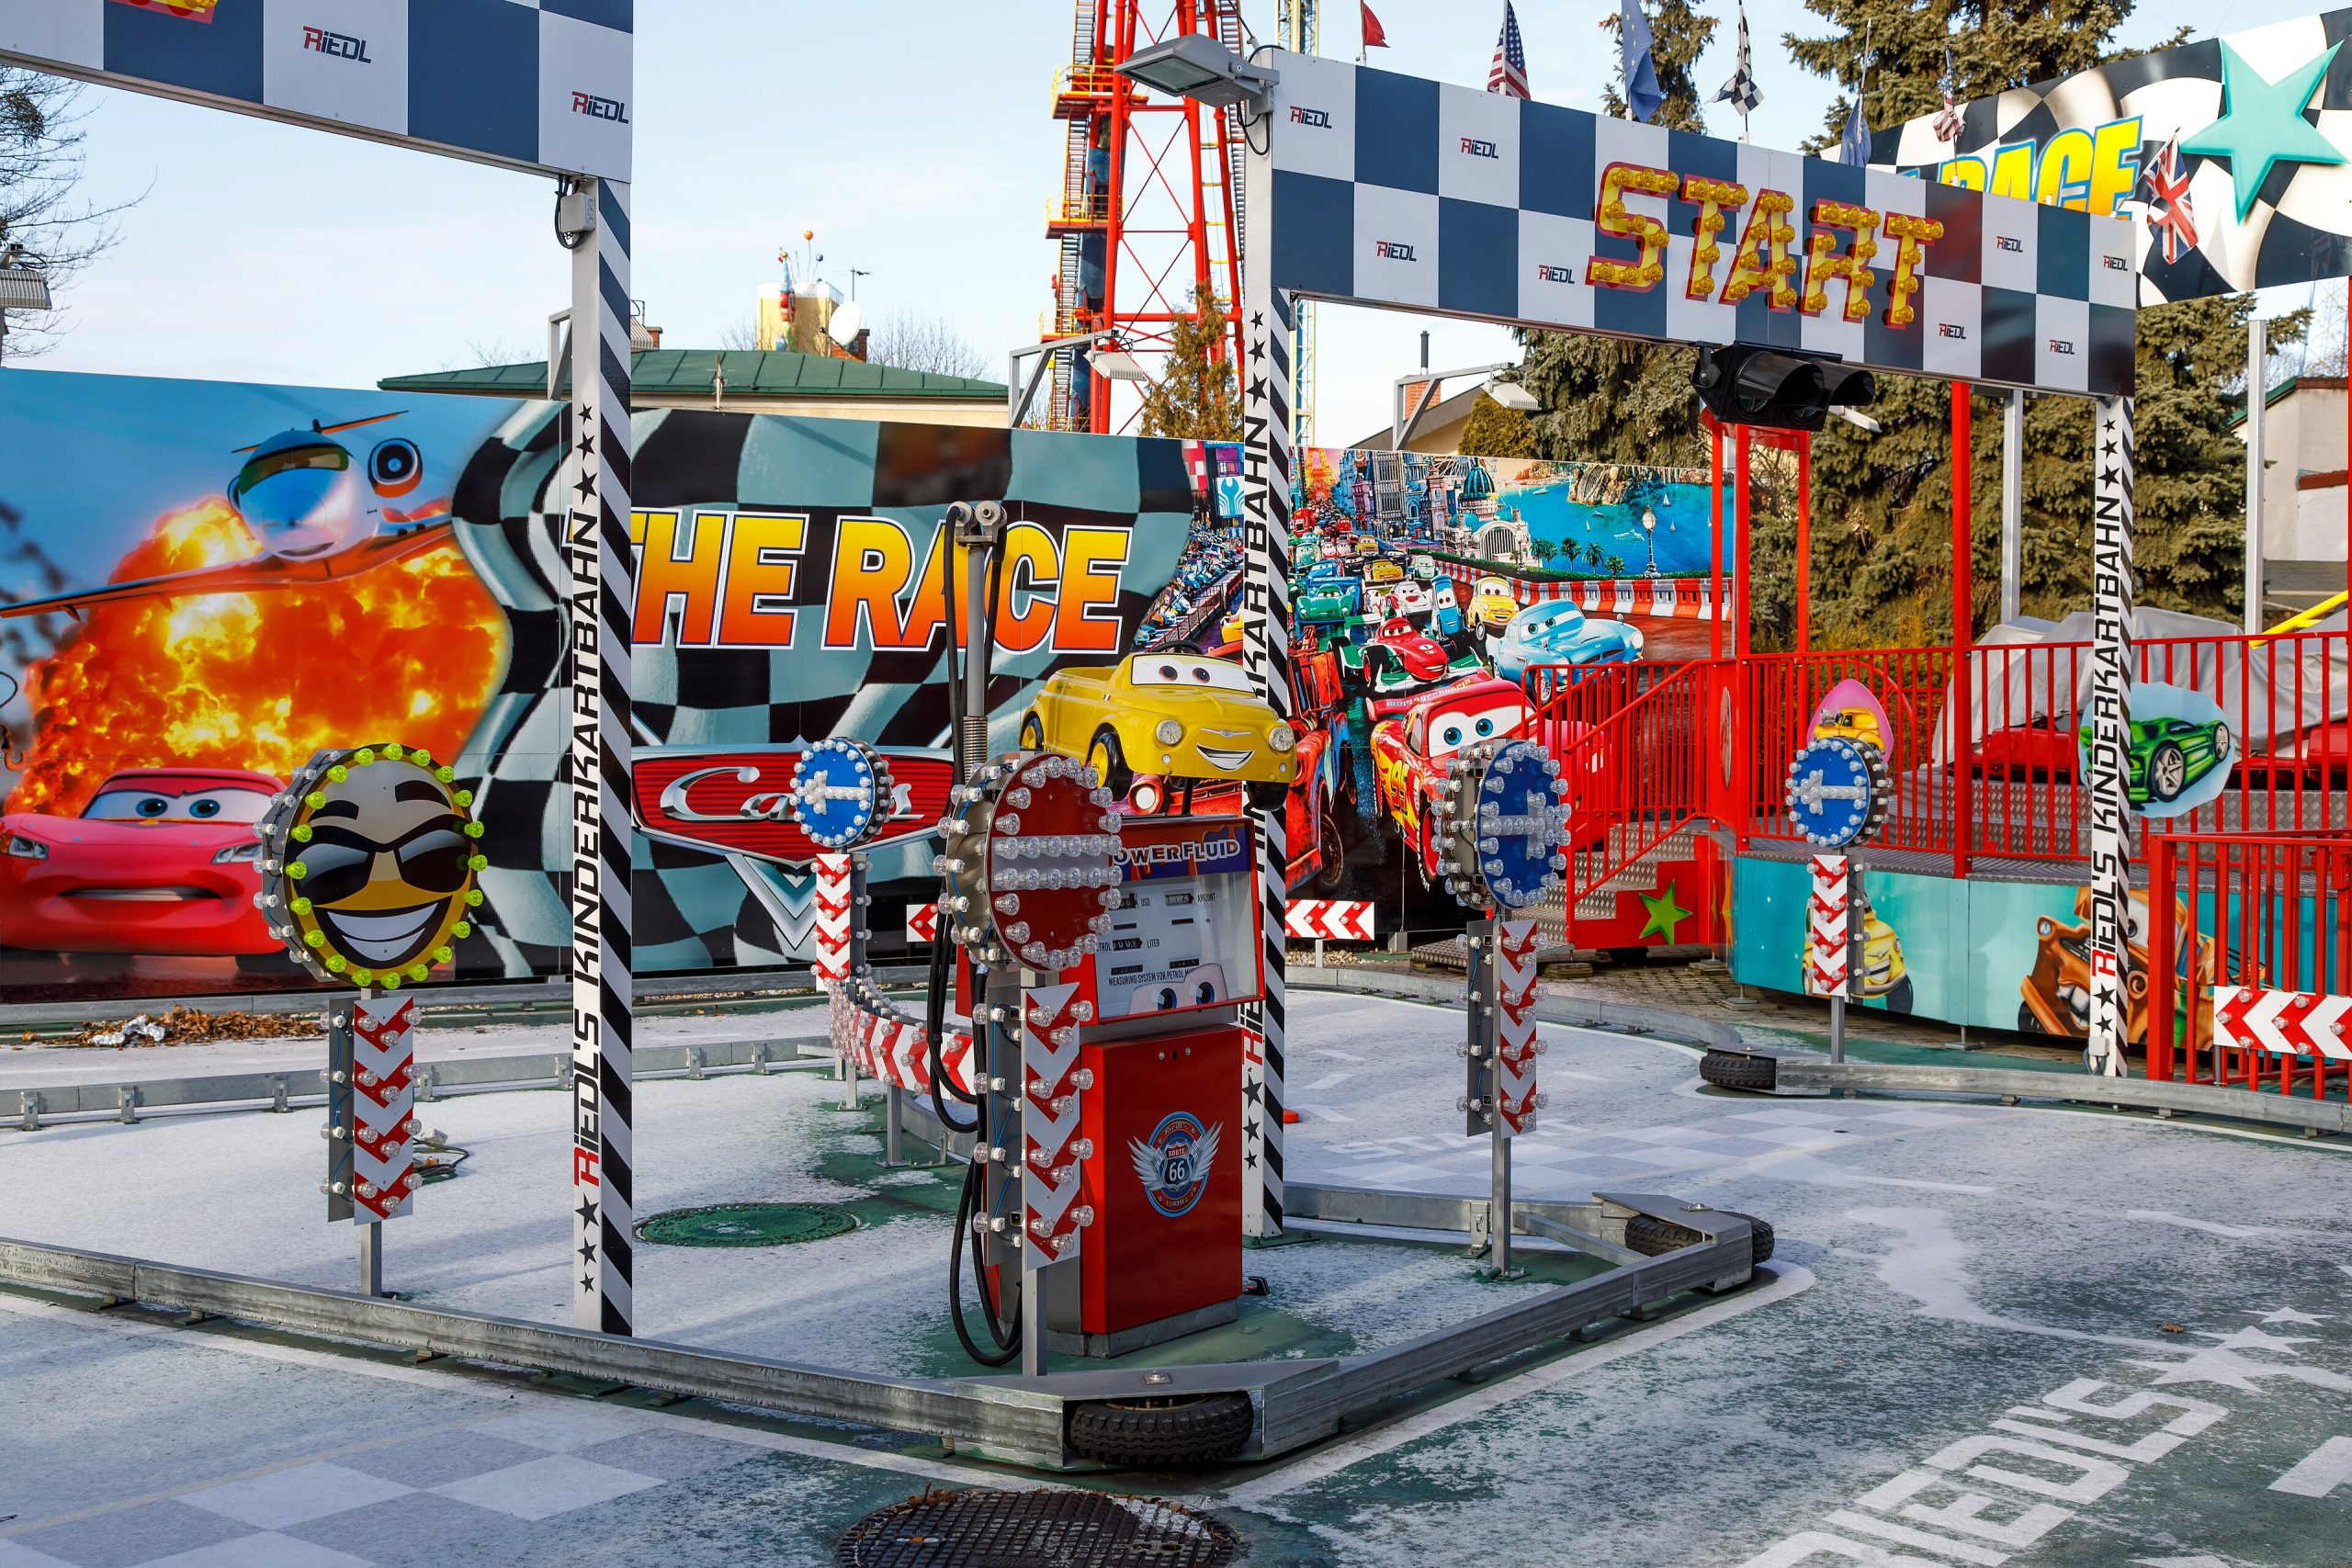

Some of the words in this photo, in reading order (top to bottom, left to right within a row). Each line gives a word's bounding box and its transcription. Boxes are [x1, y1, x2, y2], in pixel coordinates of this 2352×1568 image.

[1585, 161, 1945, 331] START
[562, 507, 808, 649] HE
[2093, 496, 2120, 835] KINDERKARTBAHN
[572, 513, 599, 987] KINDERKARTBAHN
[660, 765, 925, 822] Cas
[1140, 897, 1151, 908] USD
[1197, 892, 1216, 903] AMOUNT
[1147, 938, 1160, 949] LITER
[1108, 975, 1137, 987] MEASURING
[1137, 972, 1157, 983] SYSTEM
[1157, 971, 1167, 981] FOR
[1166, 968, 1185, 980] PETROL
[1168, 1147, 1186, 1157] ROUTE
[1169, 1160, 1185, 1182] 66
